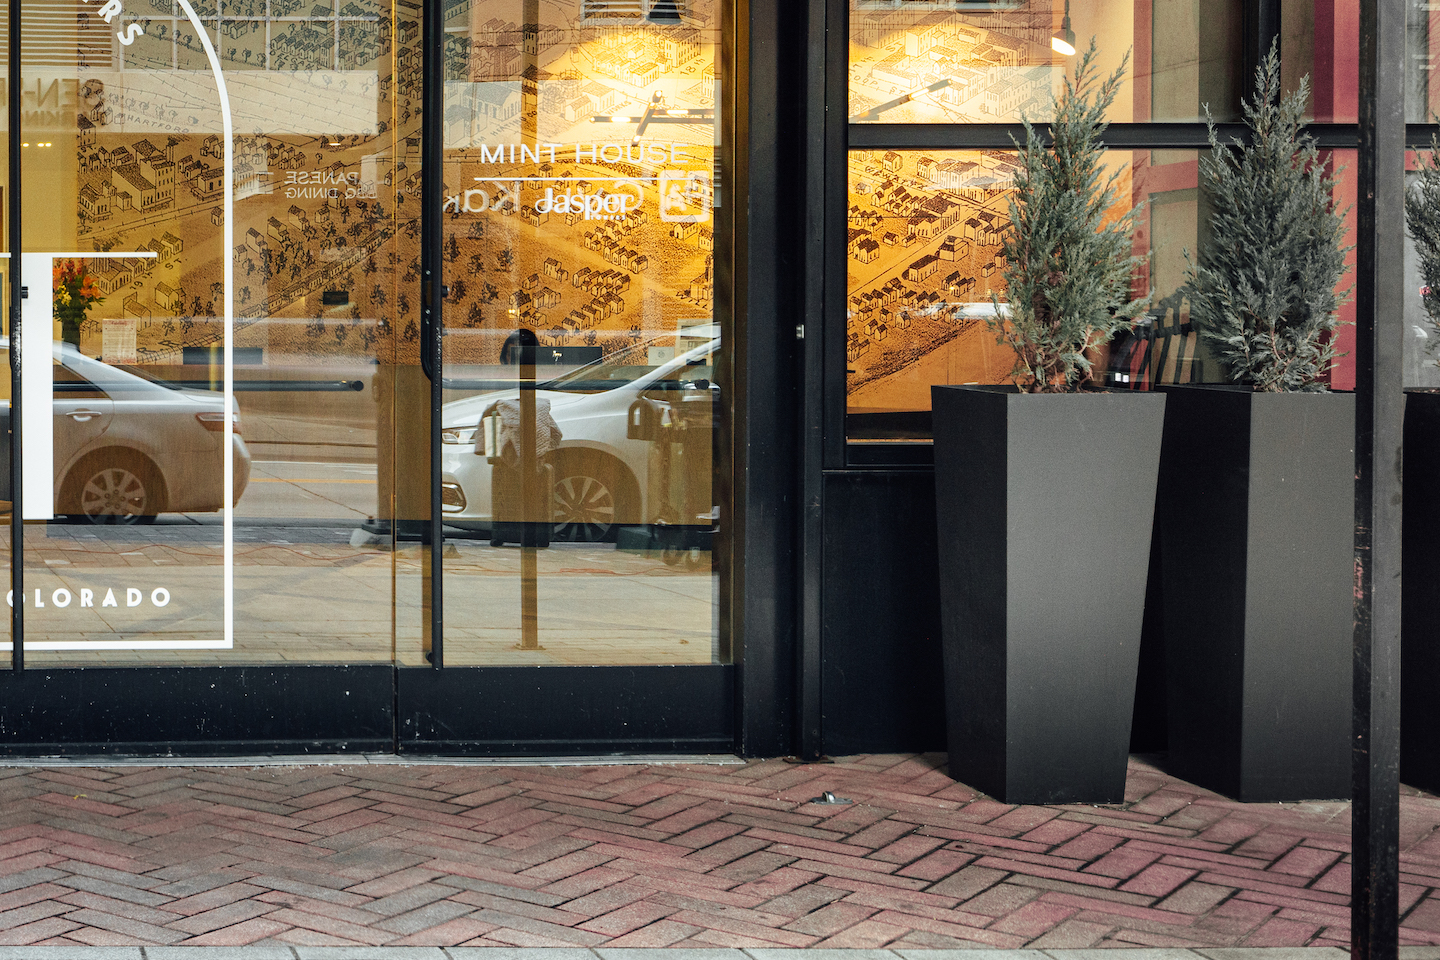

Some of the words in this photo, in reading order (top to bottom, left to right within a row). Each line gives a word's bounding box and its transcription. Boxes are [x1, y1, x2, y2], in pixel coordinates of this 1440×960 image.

[480, 144, 563, 164] MINT
[576, 144, 689, 164] HOUSE
[535, 188, 635, 221] Jasper
